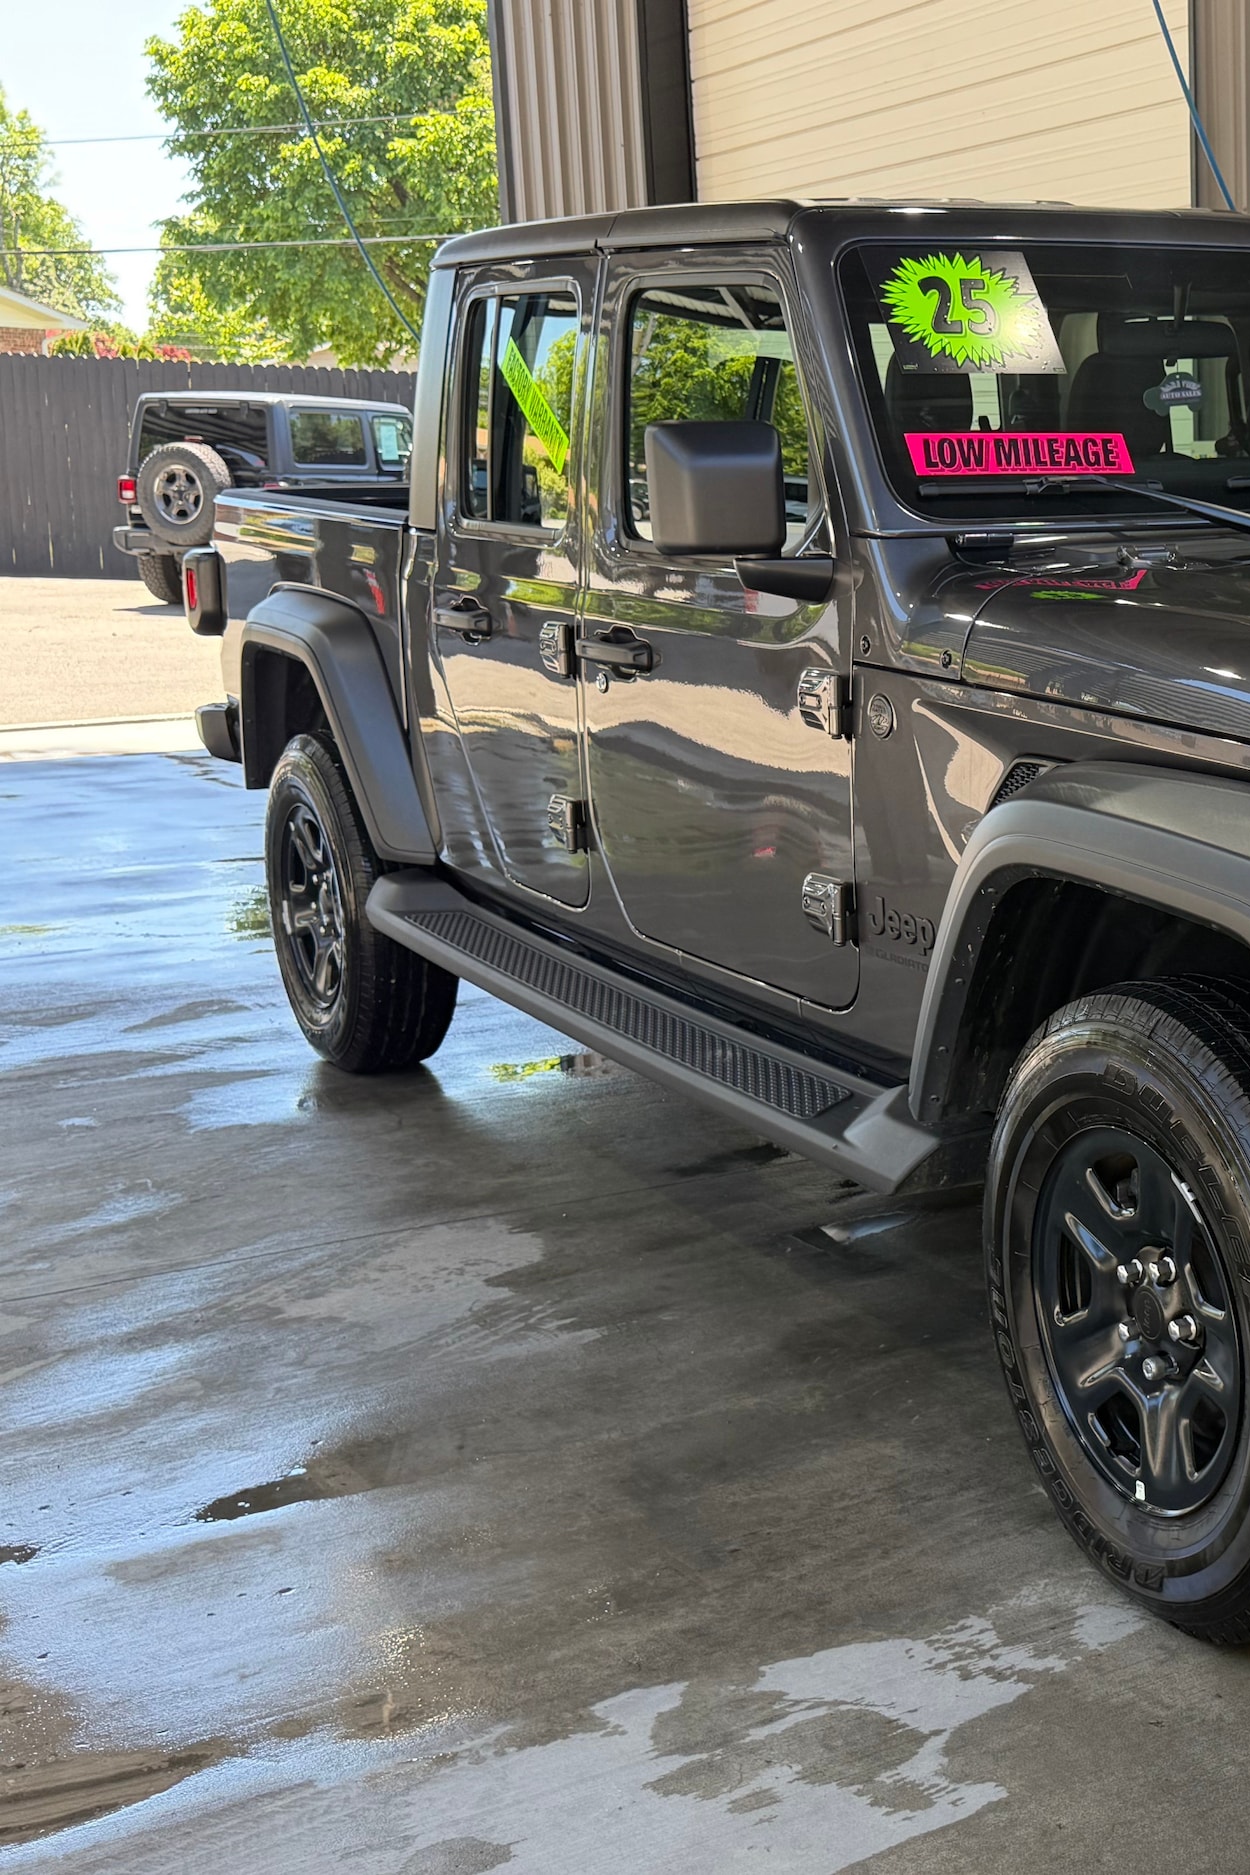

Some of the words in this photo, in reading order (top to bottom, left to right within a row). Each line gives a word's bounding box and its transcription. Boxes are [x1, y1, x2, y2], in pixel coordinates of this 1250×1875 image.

[917, 275, 997, 335] 25
[1181, 389, 1202, 398] SALES
[527, 386, 563, 465] WARRANTY
[922, 438, 987, 470] LOW
[993, 438, 1121, 470] MILEAGE
[867, 896, 937, 957] Jeep
[875, 948, 930, 973] GLADIATO
[987, 1248, 1166, 1593] BRIDGESTONE
